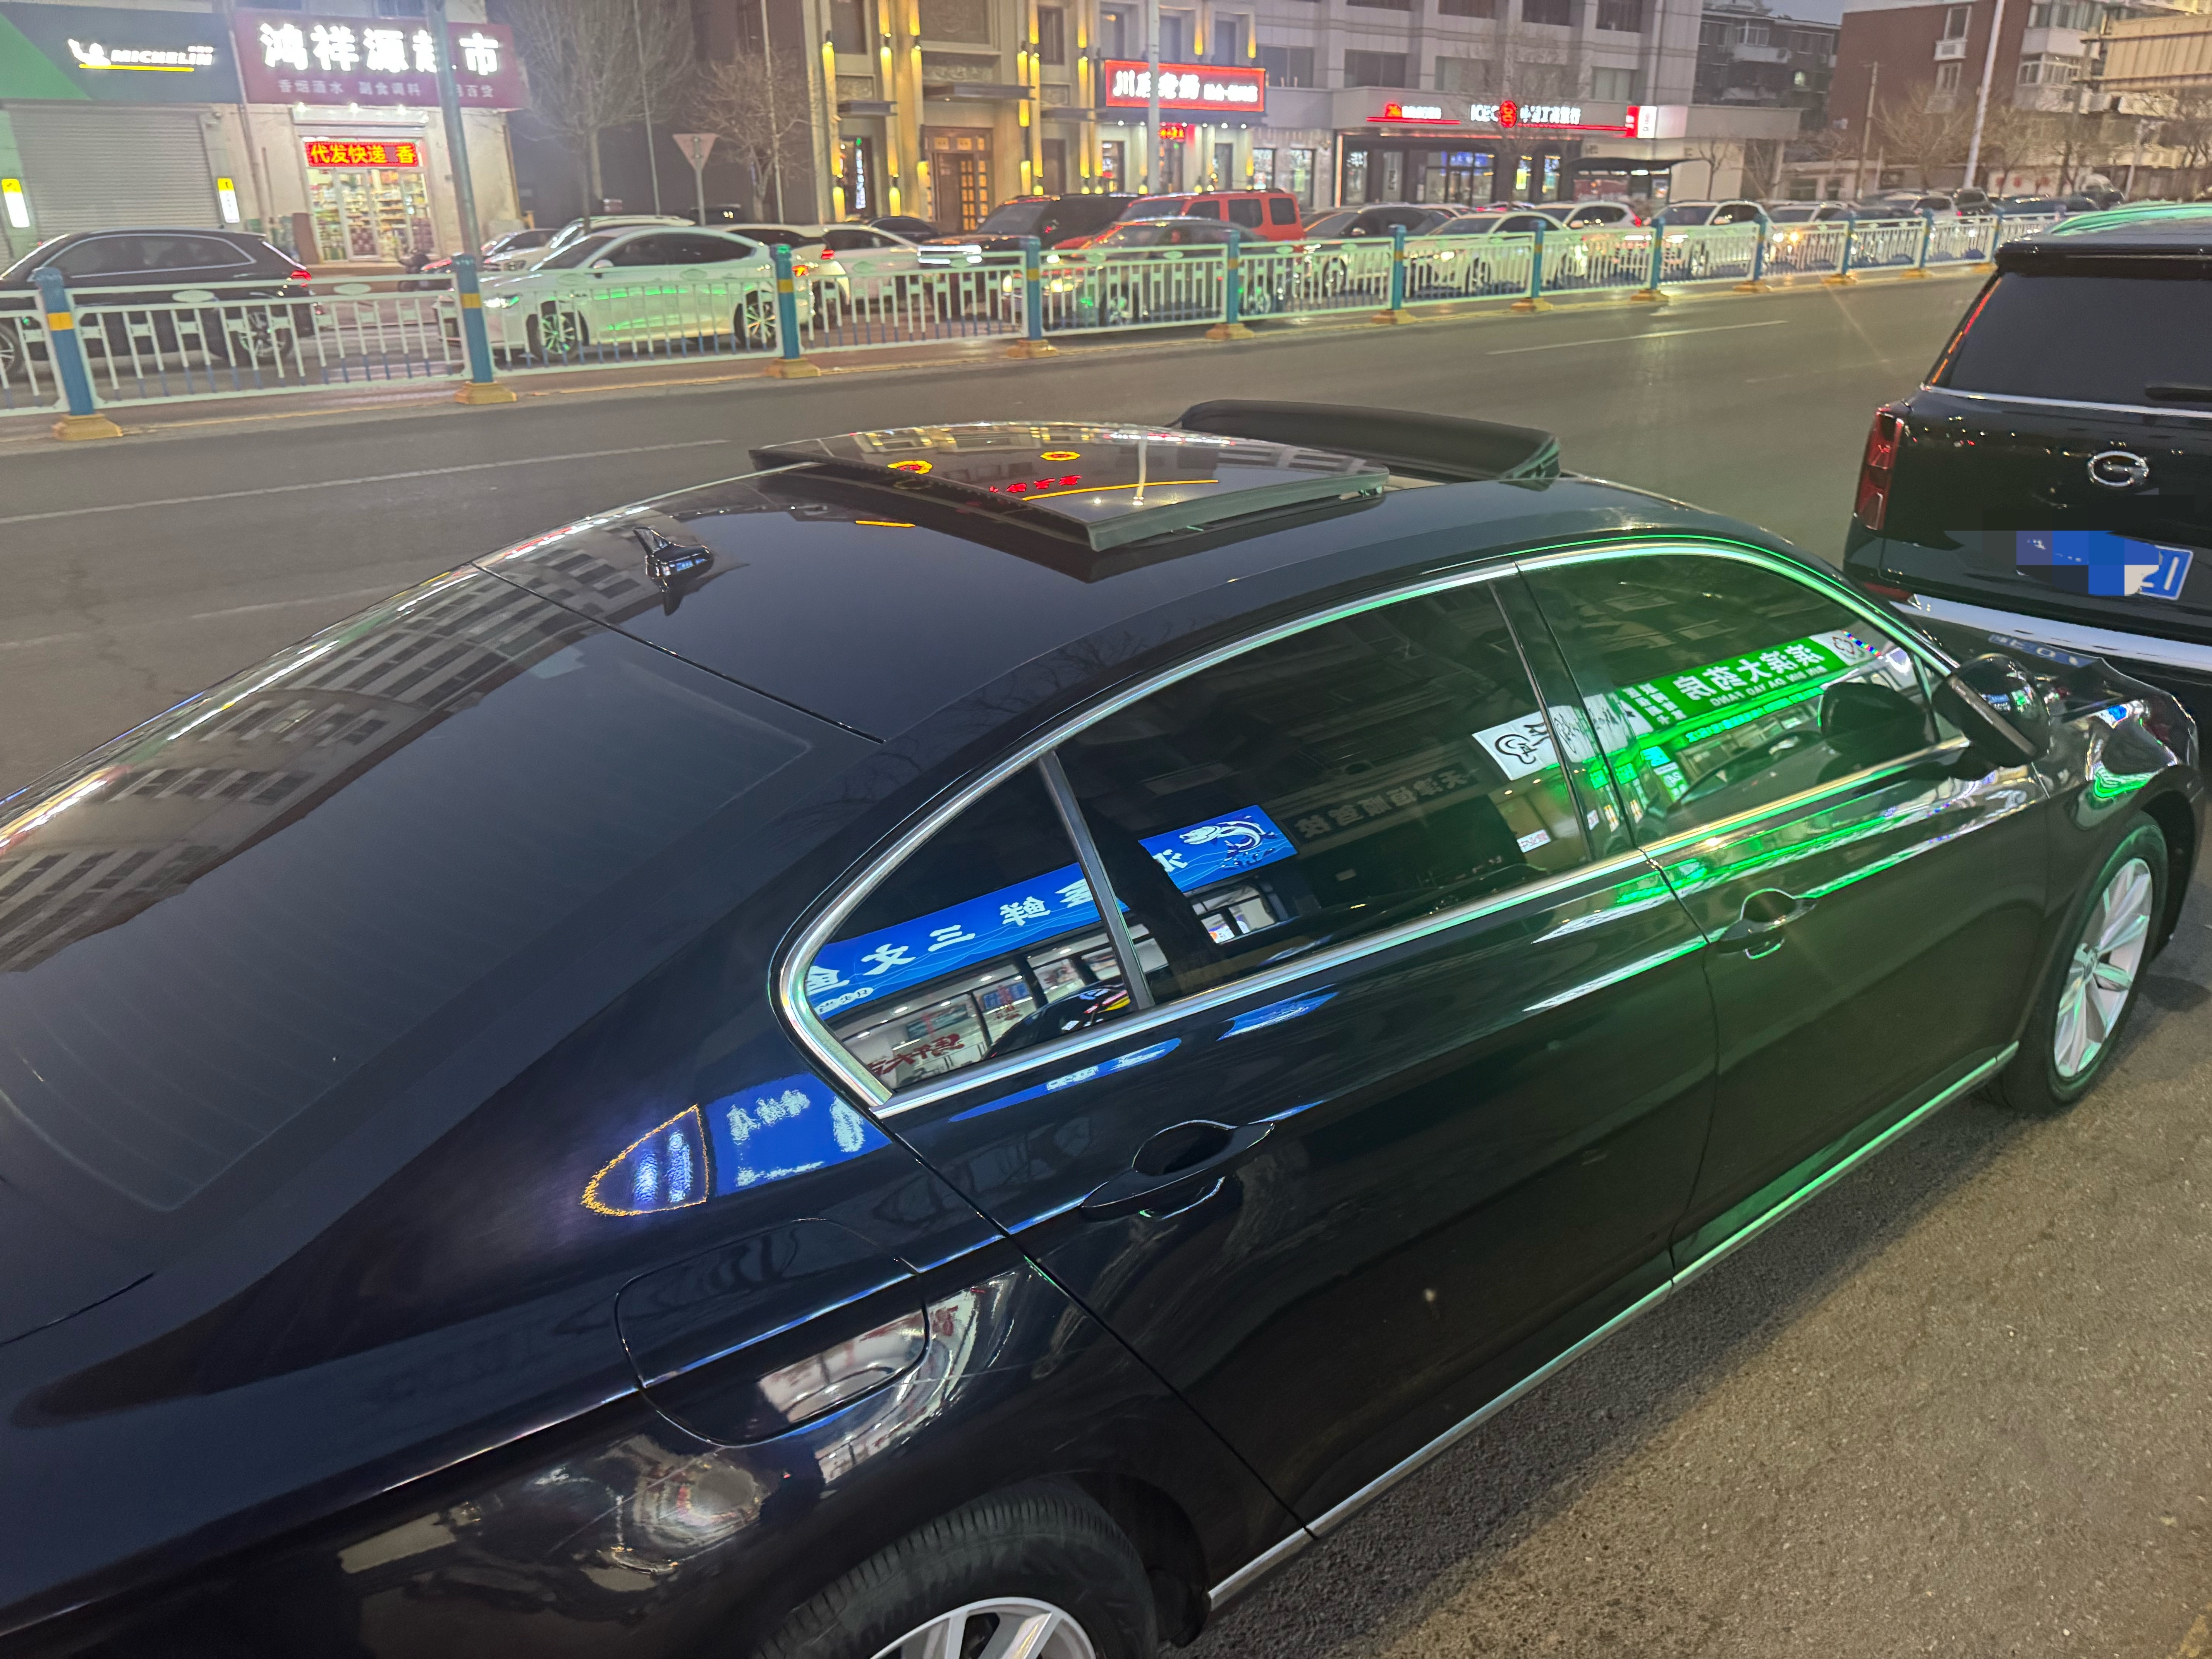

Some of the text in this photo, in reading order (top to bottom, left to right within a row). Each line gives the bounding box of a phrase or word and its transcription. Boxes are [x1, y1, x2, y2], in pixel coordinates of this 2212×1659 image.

[111, 50, 213, 65] MICHELIN
[311, 144, 414, 163] 代发快递香
